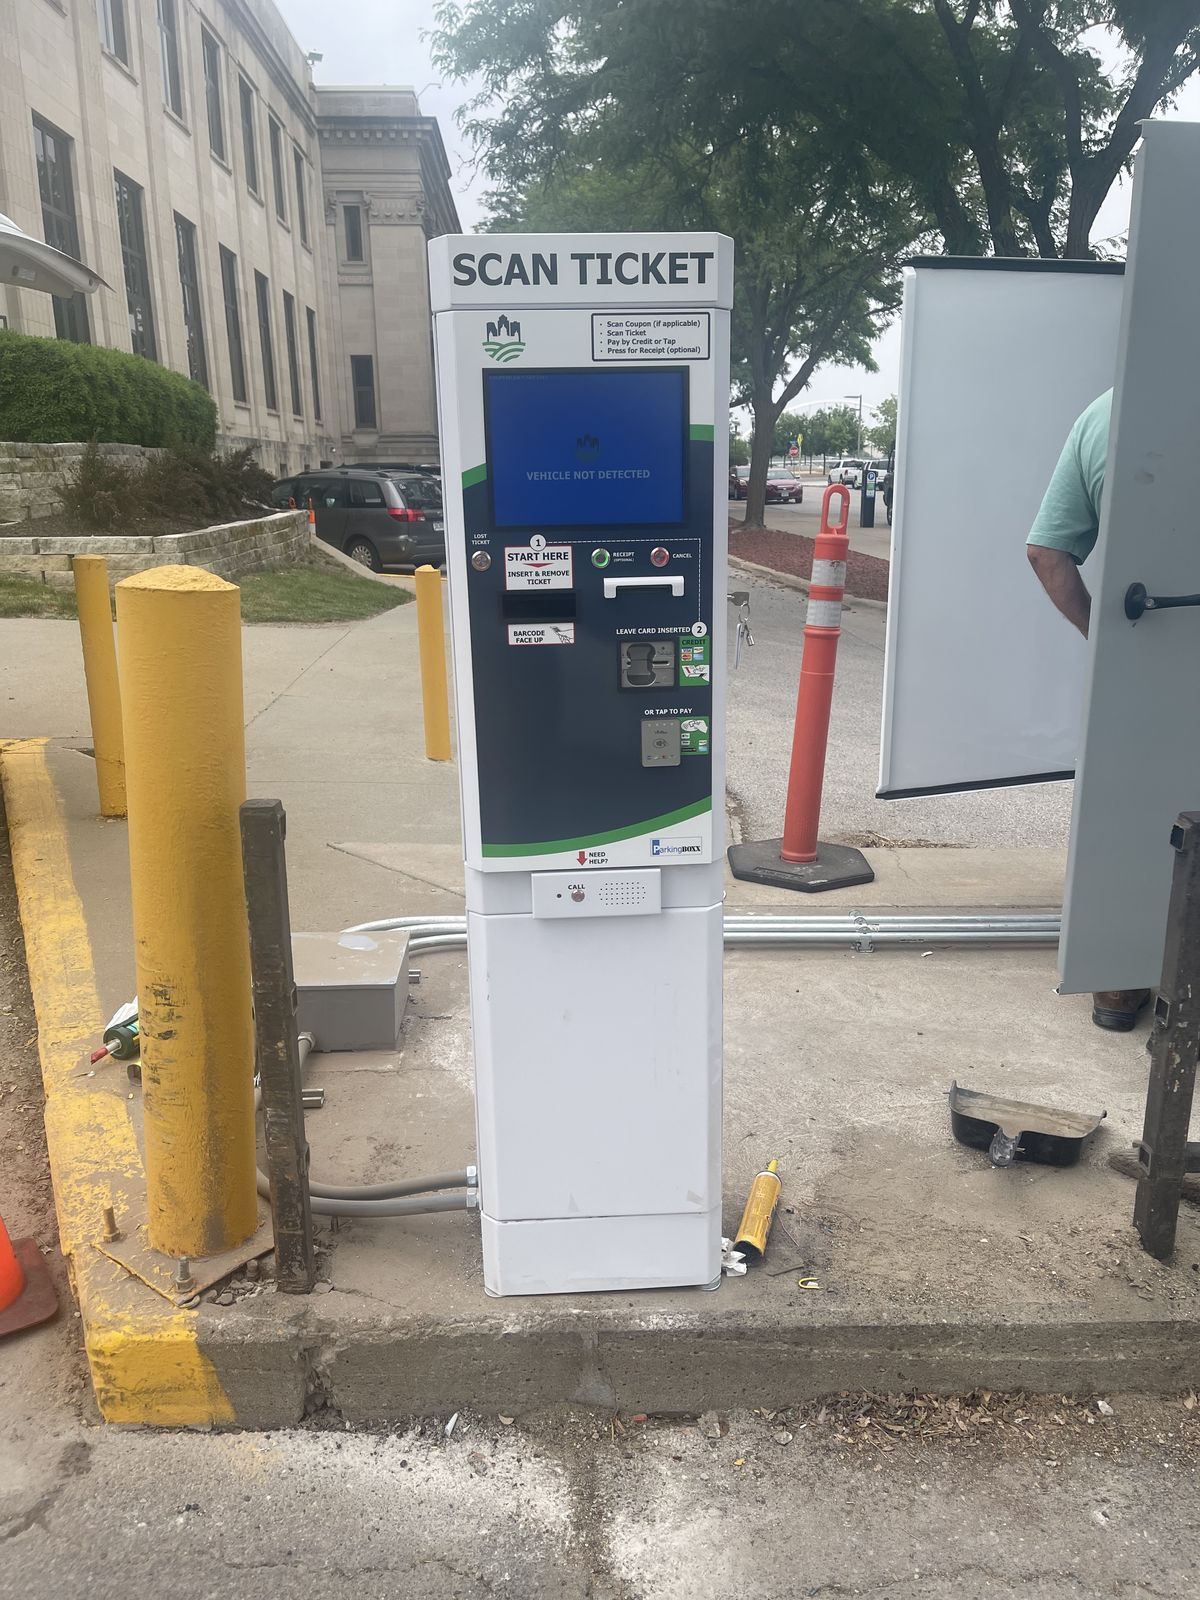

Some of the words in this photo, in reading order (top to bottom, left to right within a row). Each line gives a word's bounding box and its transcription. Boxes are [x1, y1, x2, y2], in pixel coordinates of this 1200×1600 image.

[453, 252, 558, 286] SCAN
[571, 252, 714, 285] TICKET
[625, 320, 652, 329] Coupon
[653, 320, 661, 328] (if
[663, 320, 701, 328] applicable)
[621, 338, 630, 346] by
[639, 347, 665, 355] Receipt
[526, 472, 571, 480] VEHICLE
[573, 471, 596, 480] NOT
[598, 470, 650, 479] DETECTED
[535, 538, 541, 546] 1
[507, 552, 540, 561] START
[542, 552, 569, 560] HERE
[513, 629, 546, 637] BARCODE
[657, 626, 691, 634] INSERTED
[696, 625, 703, 634] 2
